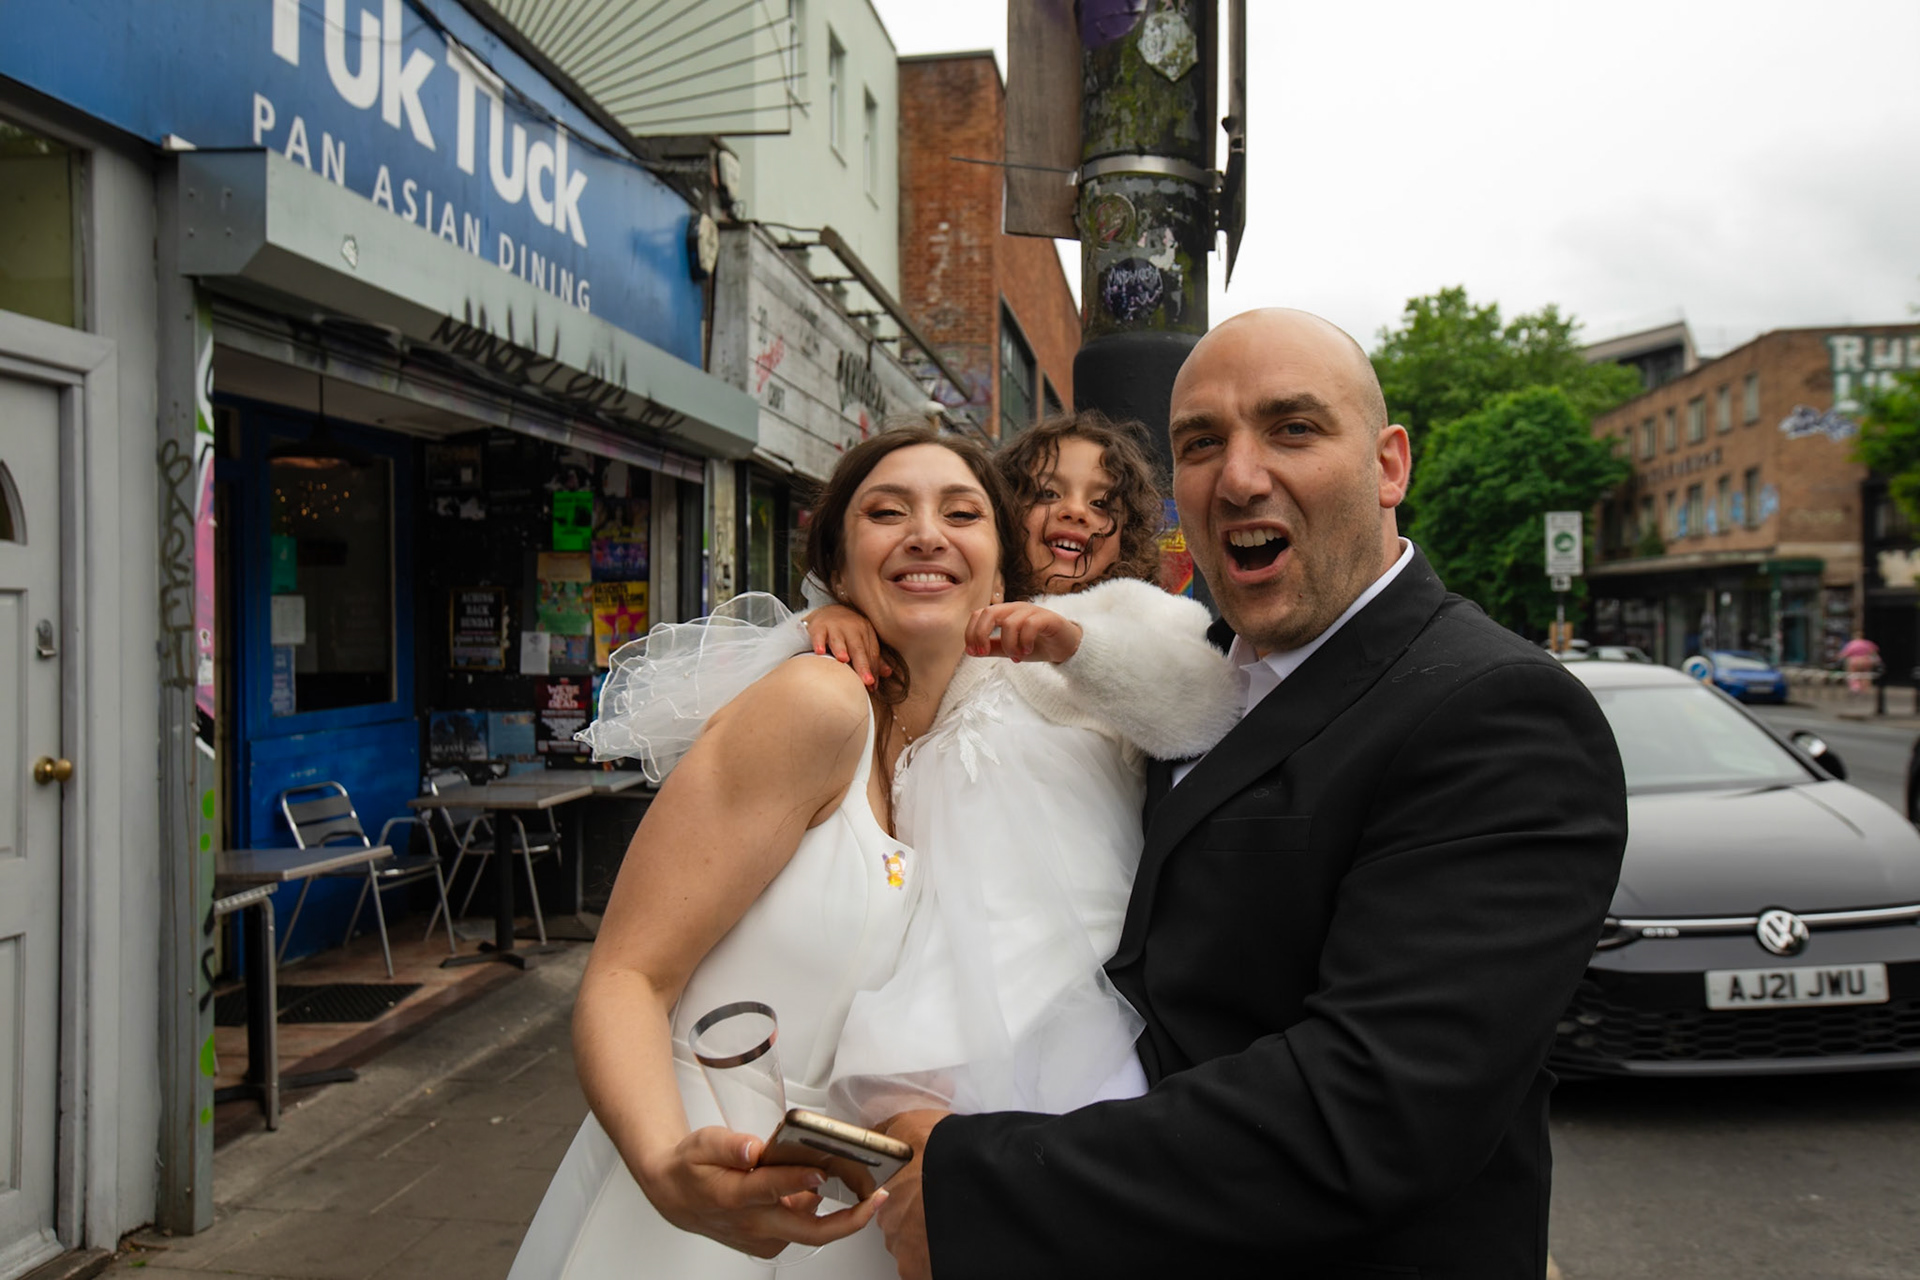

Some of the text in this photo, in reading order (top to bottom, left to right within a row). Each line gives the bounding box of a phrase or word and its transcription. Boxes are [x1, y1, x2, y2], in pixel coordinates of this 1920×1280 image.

[253, 92, 591, 313] PAN ASIAN DINING
[1728, 969, 1866, 1002] AJ21 JWU
